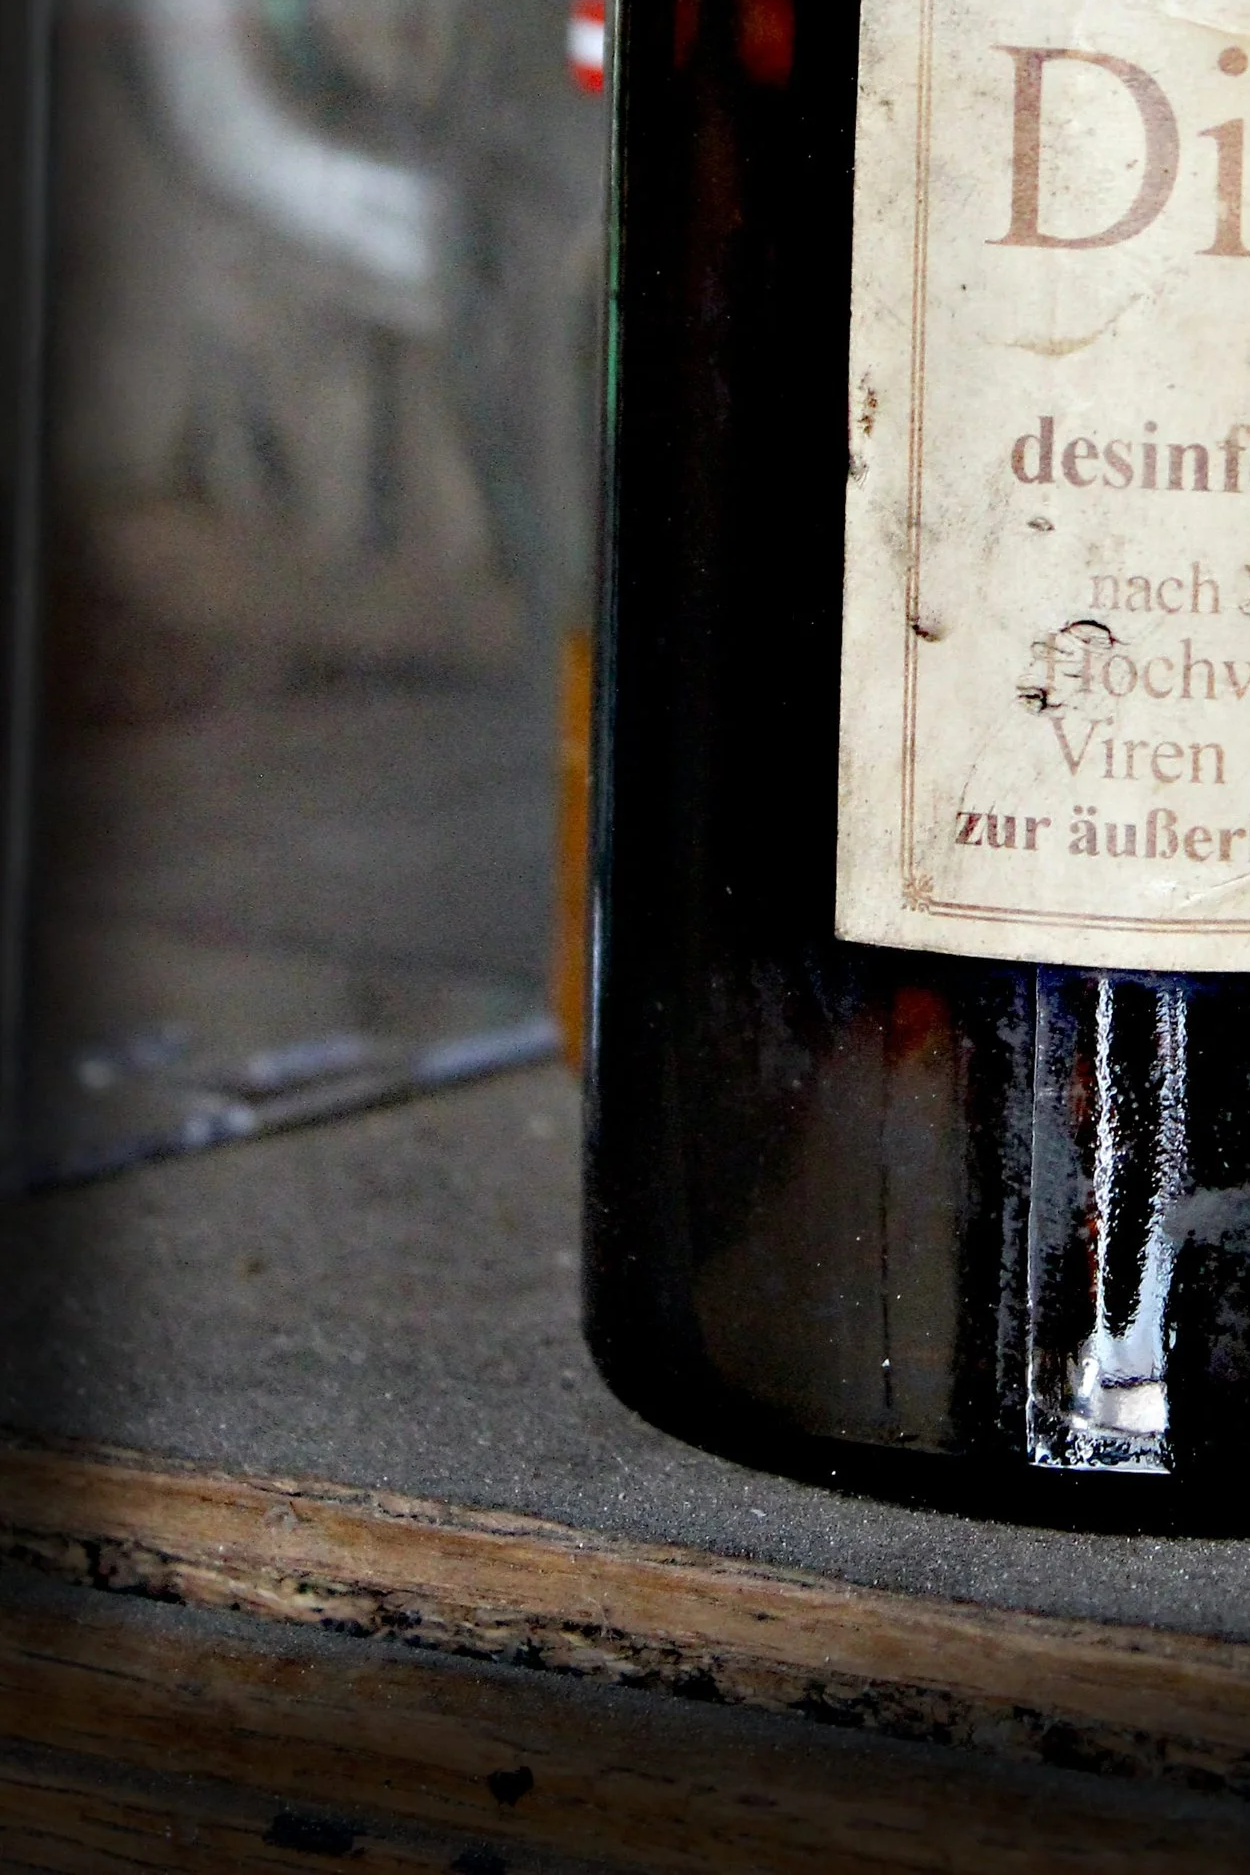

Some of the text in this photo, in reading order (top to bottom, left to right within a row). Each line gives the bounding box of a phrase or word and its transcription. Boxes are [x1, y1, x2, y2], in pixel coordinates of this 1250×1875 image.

[1089, 562, 1222, 616] nach
[1050, 717, 1225, 786] Viren
[955, 808, 1052, 852] zur
